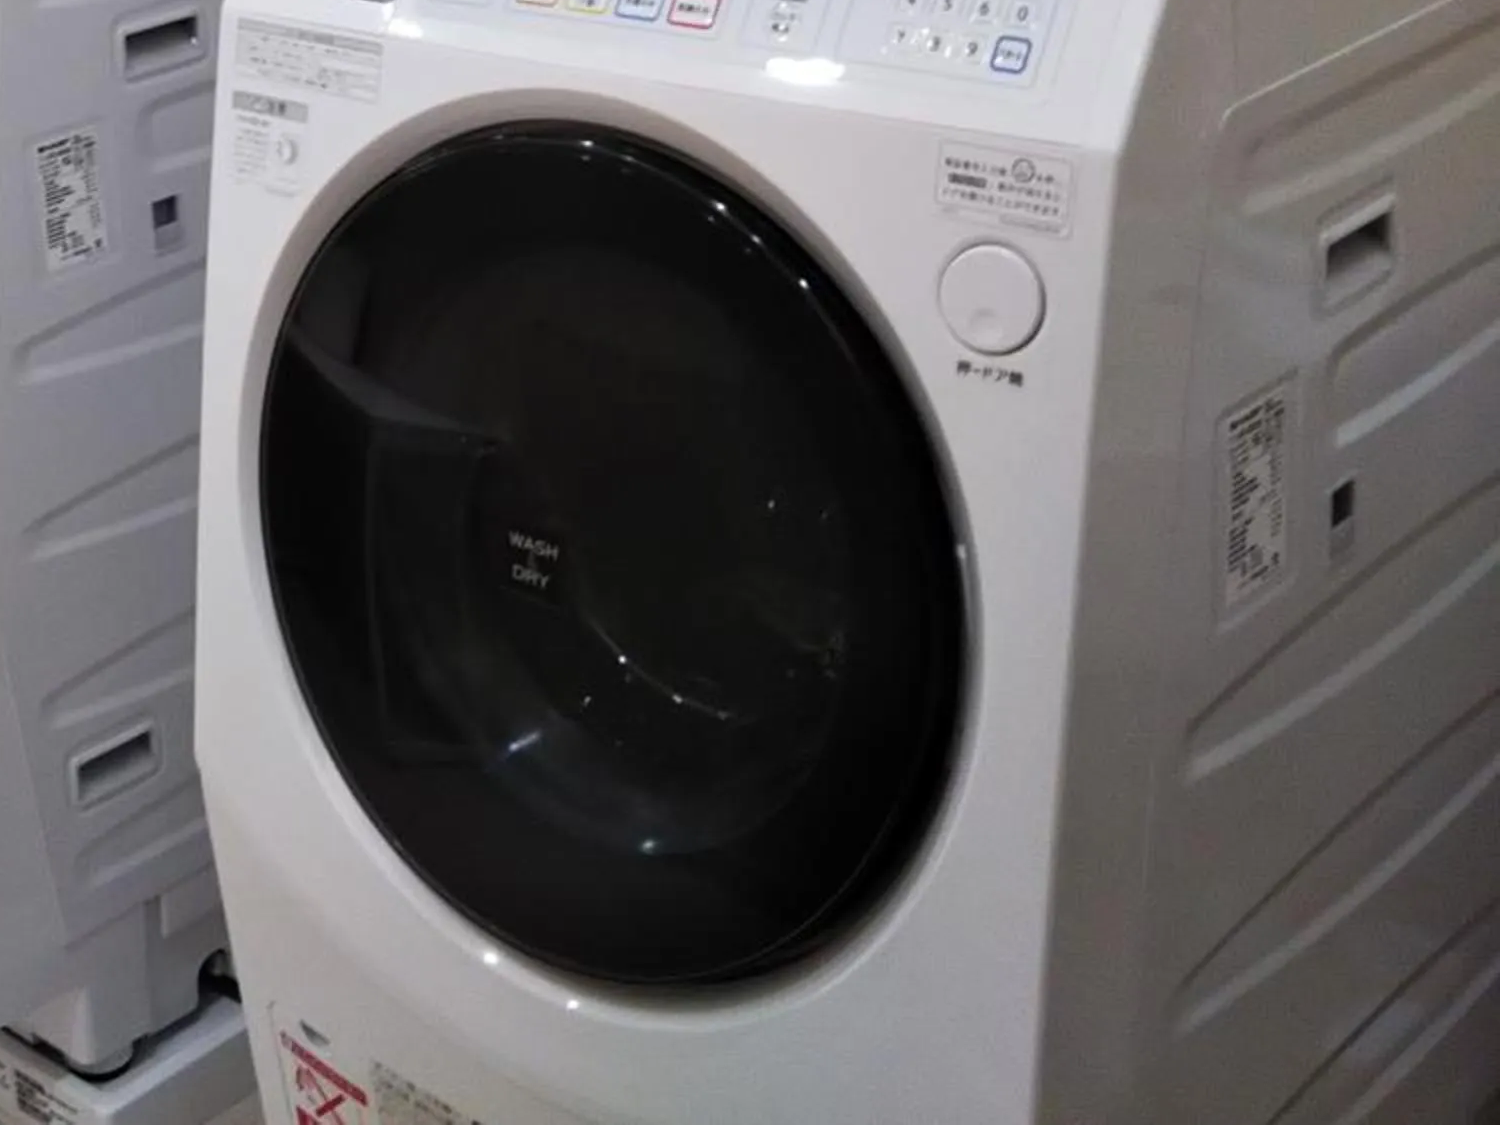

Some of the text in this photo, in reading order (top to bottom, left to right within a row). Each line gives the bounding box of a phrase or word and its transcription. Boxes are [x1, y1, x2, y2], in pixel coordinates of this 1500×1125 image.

[978, 0, 990, 16] 6
[1017, 5, 1029, 22] 0
[508, 530, 559, 561] WASH
[512, 564, 549, 590] DRY
